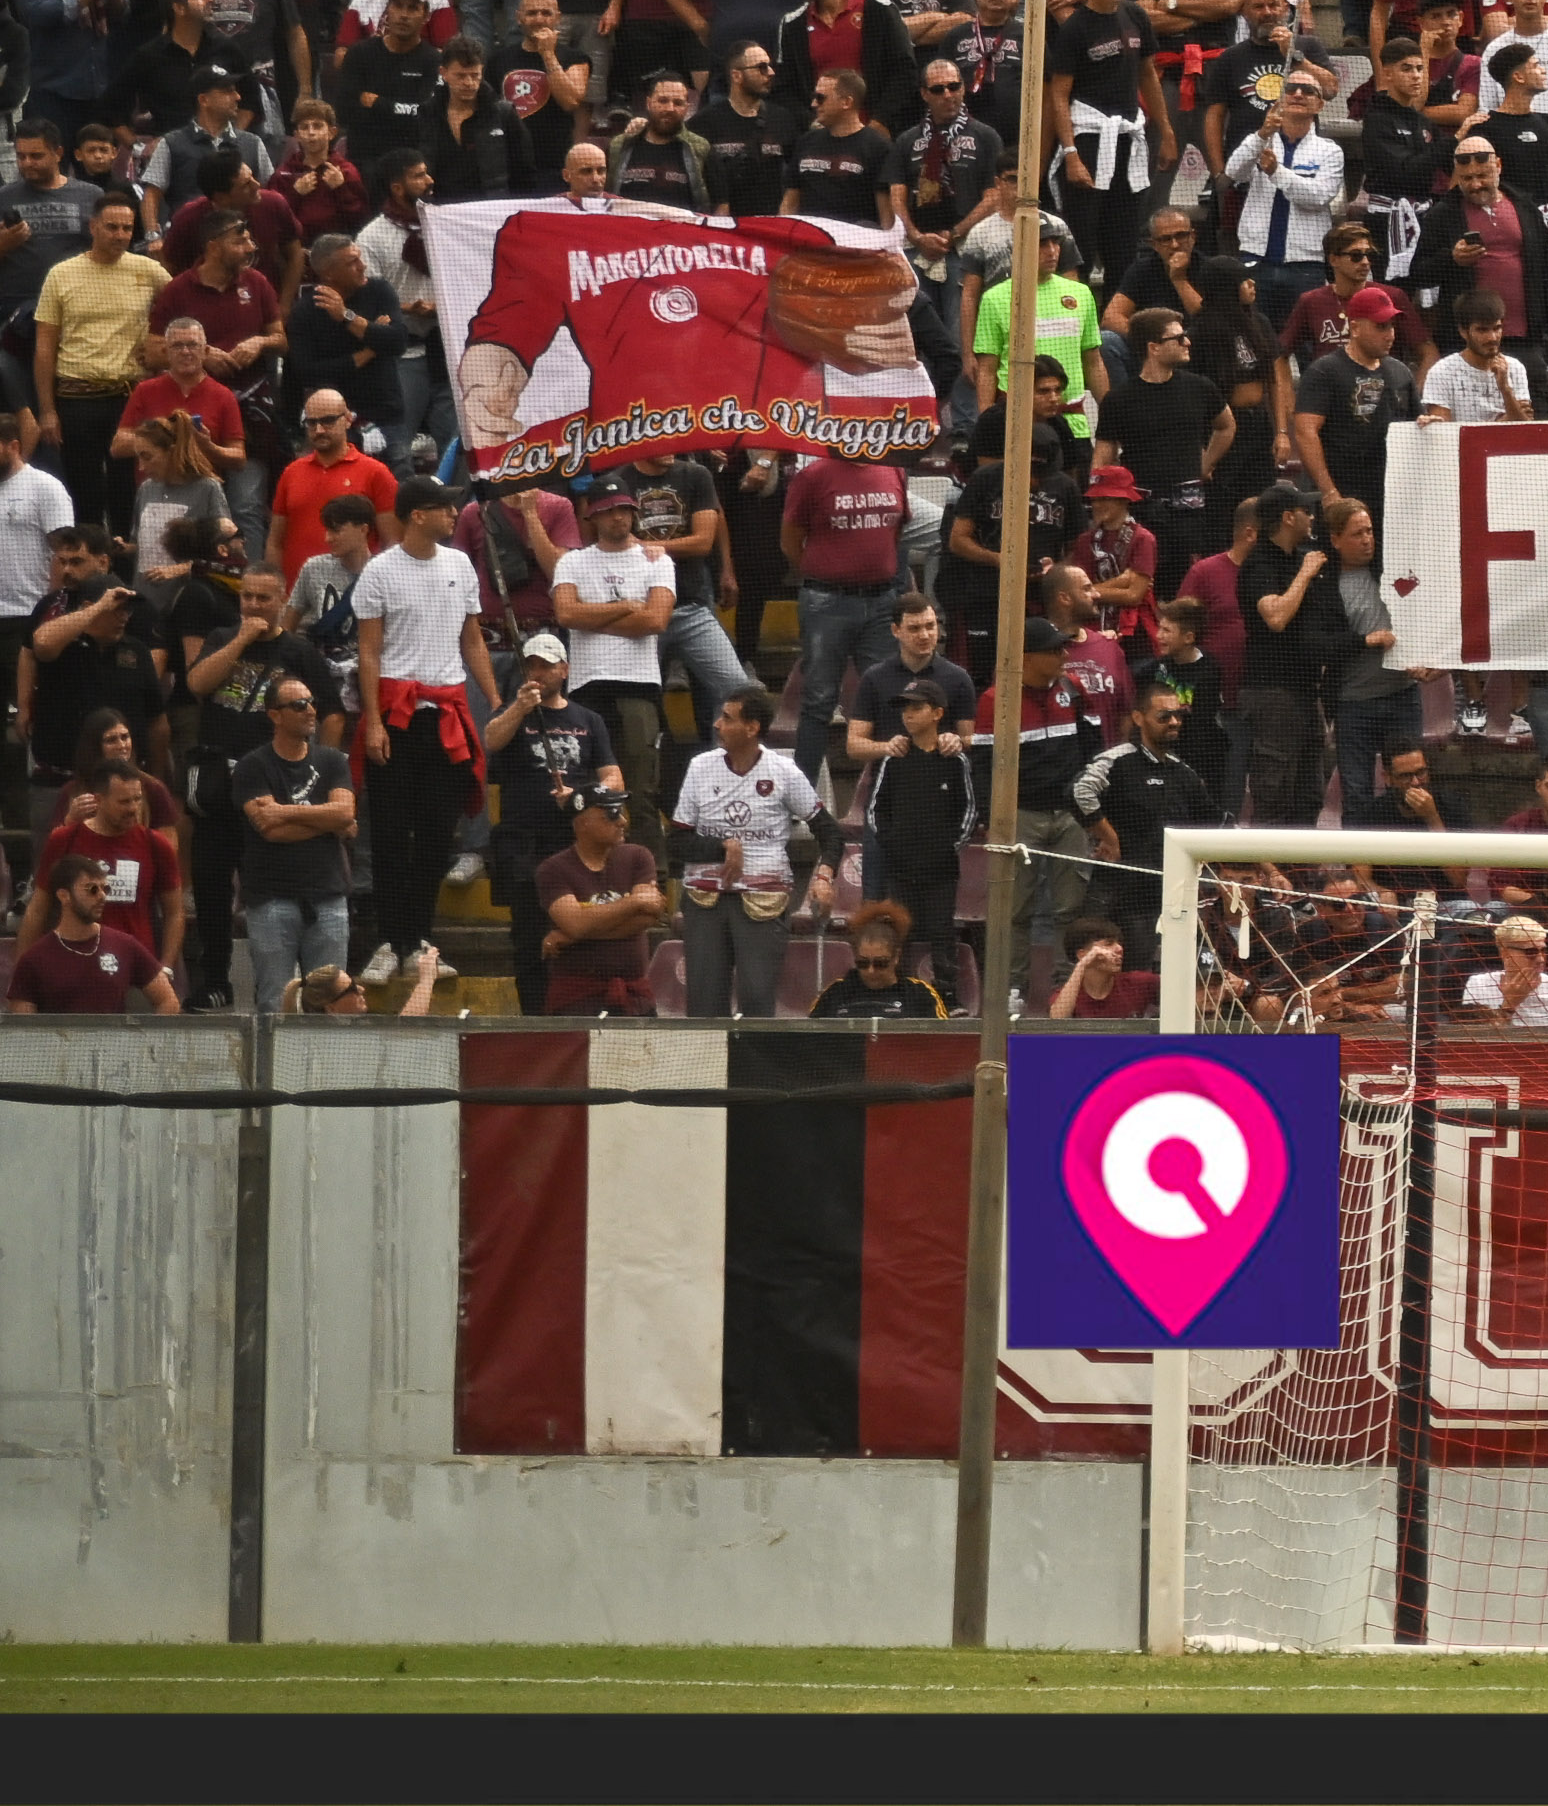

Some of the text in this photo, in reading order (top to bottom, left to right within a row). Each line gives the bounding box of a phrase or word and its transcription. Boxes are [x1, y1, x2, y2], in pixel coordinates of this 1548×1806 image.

[497, 395, 936, 480] La Jonica che Viaggia
[834, 492, 898, 510] PER LA MAGLIA
[830, 515, 849, 531] PER
[849, 515, 863, 530] LA
[864, 514, 881, 529] MIA
